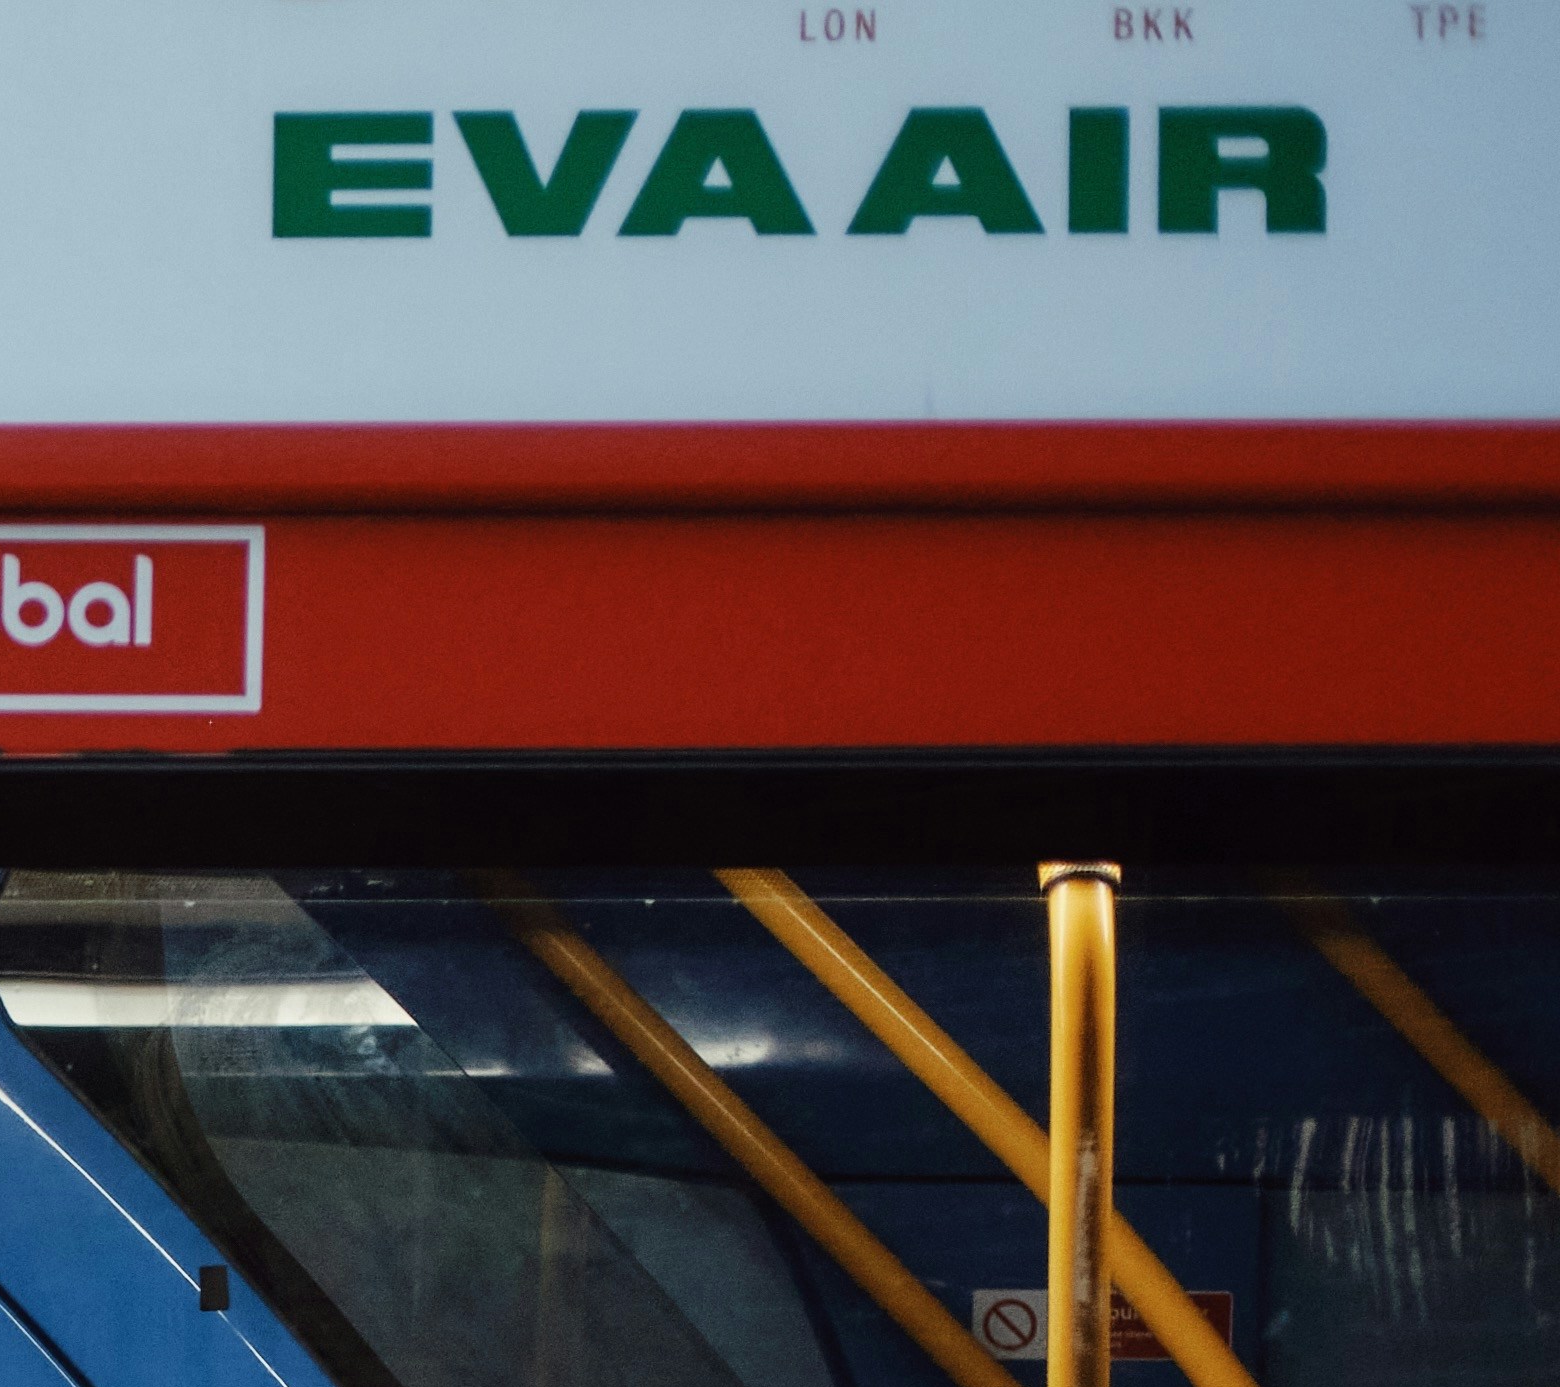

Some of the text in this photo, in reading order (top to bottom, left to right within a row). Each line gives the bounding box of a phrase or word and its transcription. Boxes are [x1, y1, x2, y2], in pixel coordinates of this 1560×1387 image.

[799, 8, 877, 43] LON
[1113, 8, 1194, 41] BKK
[1409, 4, 1487, 39] TPE
